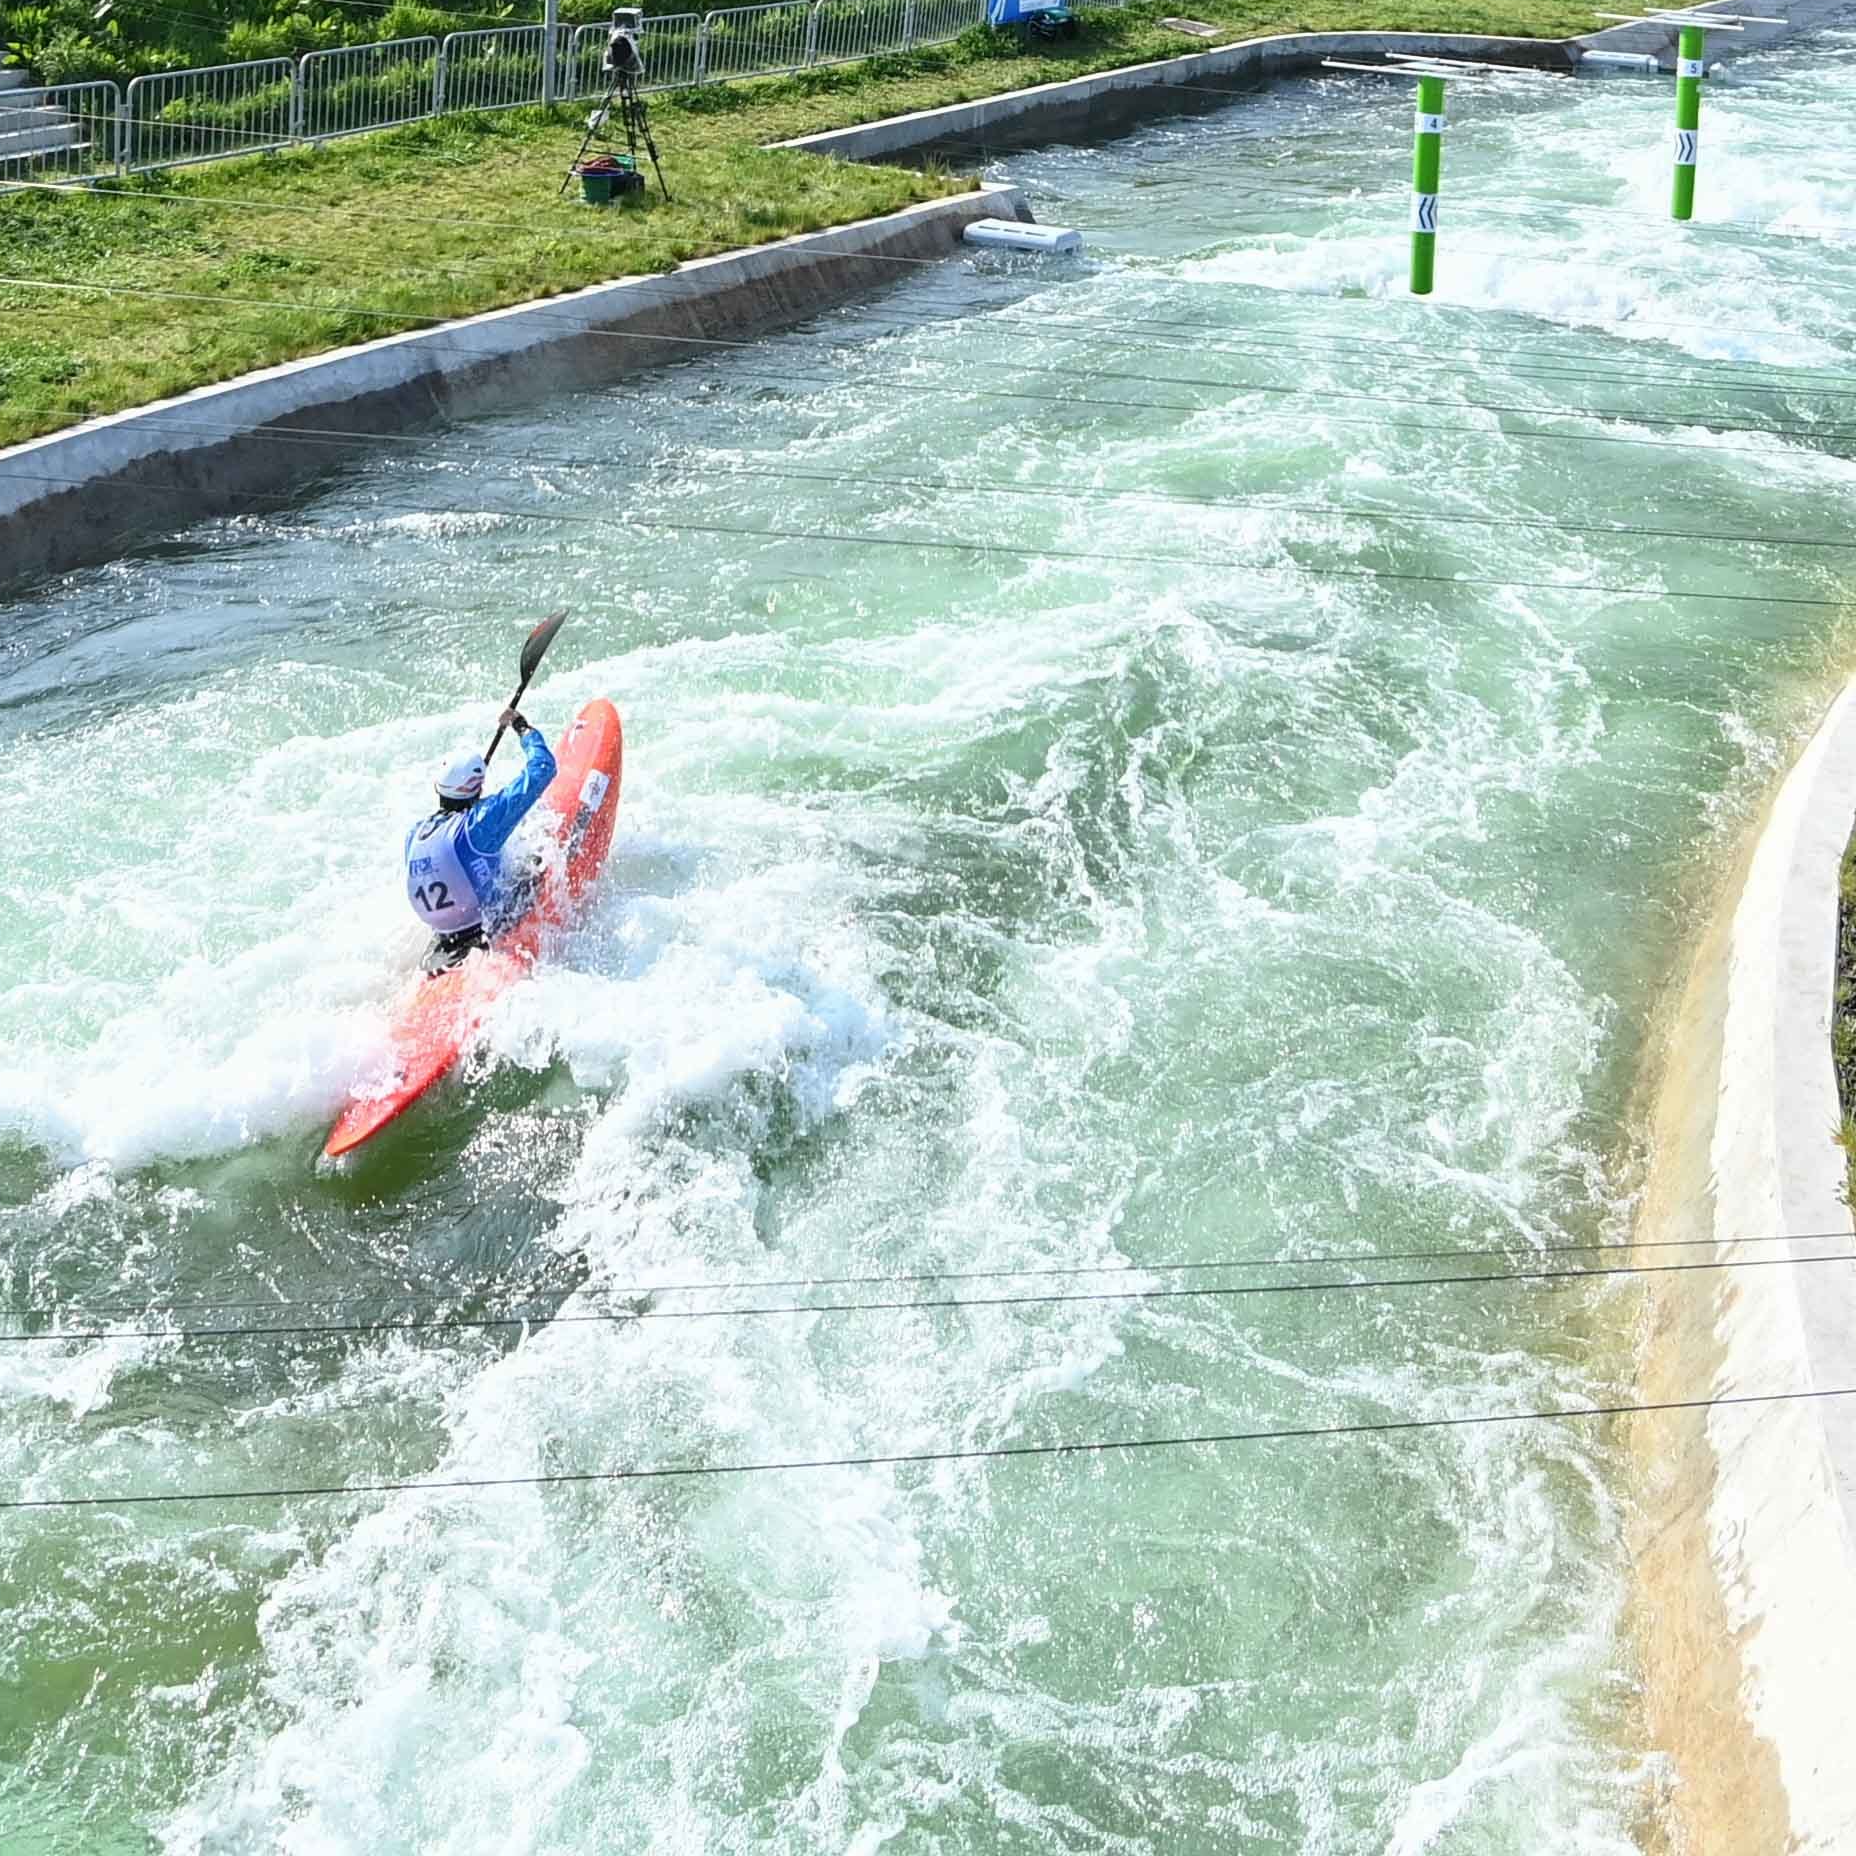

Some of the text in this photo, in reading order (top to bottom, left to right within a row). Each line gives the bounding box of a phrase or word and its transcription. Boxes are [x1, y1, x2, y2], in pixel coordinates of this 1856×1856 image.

[1690, 62, 1697, 75] 5
[1429, 117, 1438, 129] 4
[415, 881, 455, 912] 12
